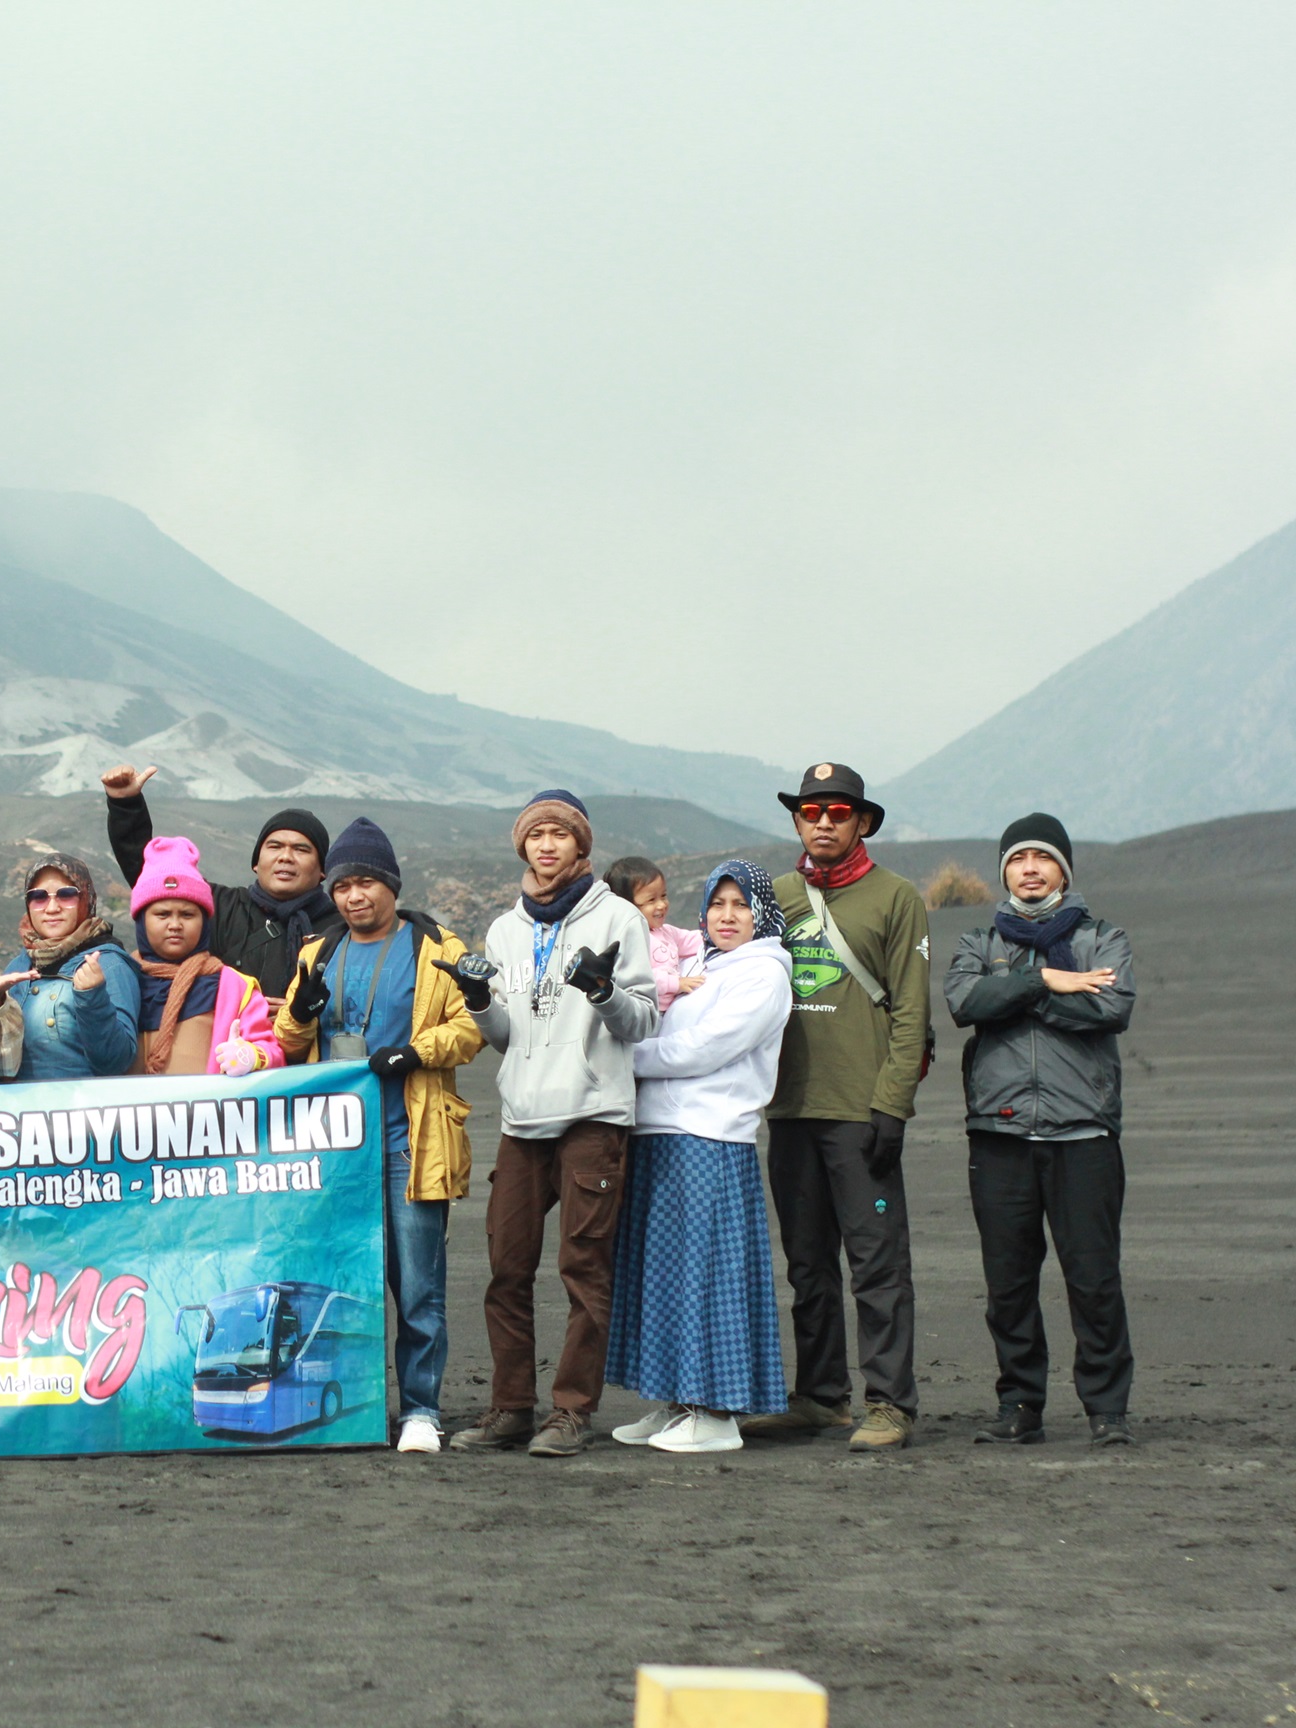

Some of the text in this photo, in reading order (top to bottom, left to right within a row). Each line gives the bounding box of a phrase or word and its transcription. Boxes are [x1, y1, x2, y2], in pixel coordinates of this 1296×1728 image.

[267, 1092, 366, 1155] LKD
[129, 1178, 144, 1193] -
[150, 1164, 229, 1205] Jawa
[235, 1155, 323, 1195] Barat
